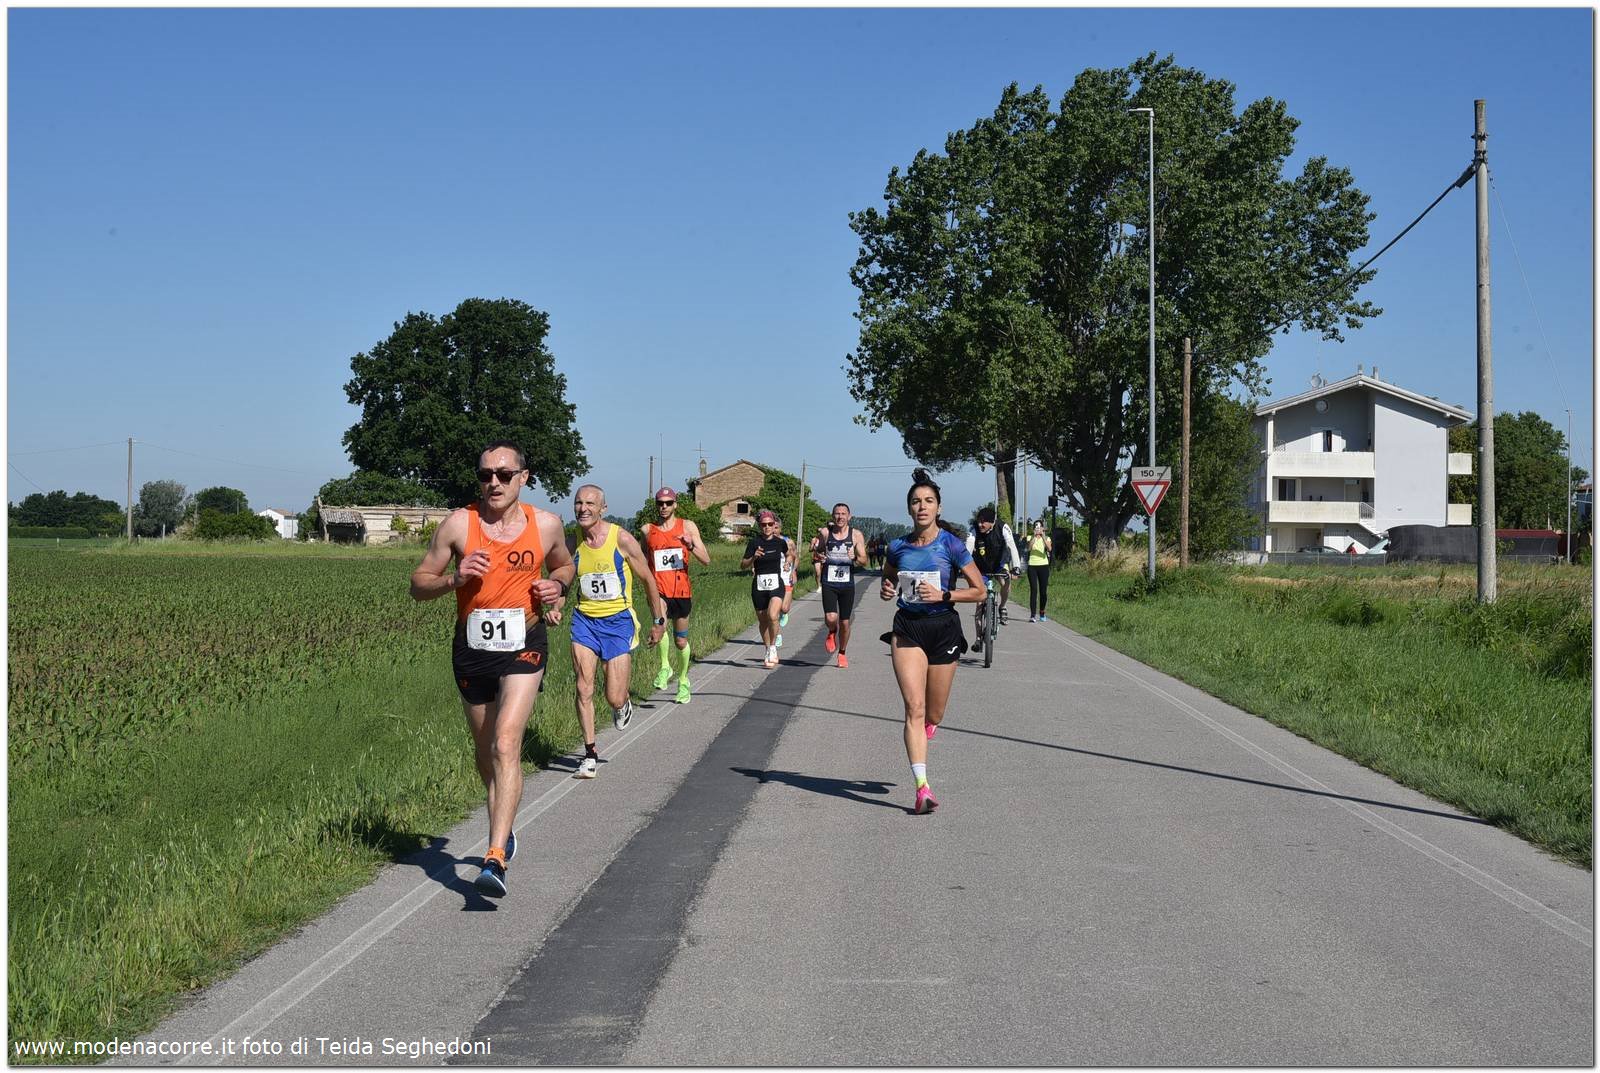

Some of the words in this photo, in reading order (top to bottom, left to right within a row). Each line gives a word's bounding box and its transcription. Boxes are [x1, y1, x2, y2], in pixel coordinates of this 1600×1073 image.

[1140, 469, 1154, 477] 150
[662, 554, 676, 566] 84
[591, 579, 607, 594] 51
[763, 578, 773, 587] 12
[481, 620, 507, 641] 91
